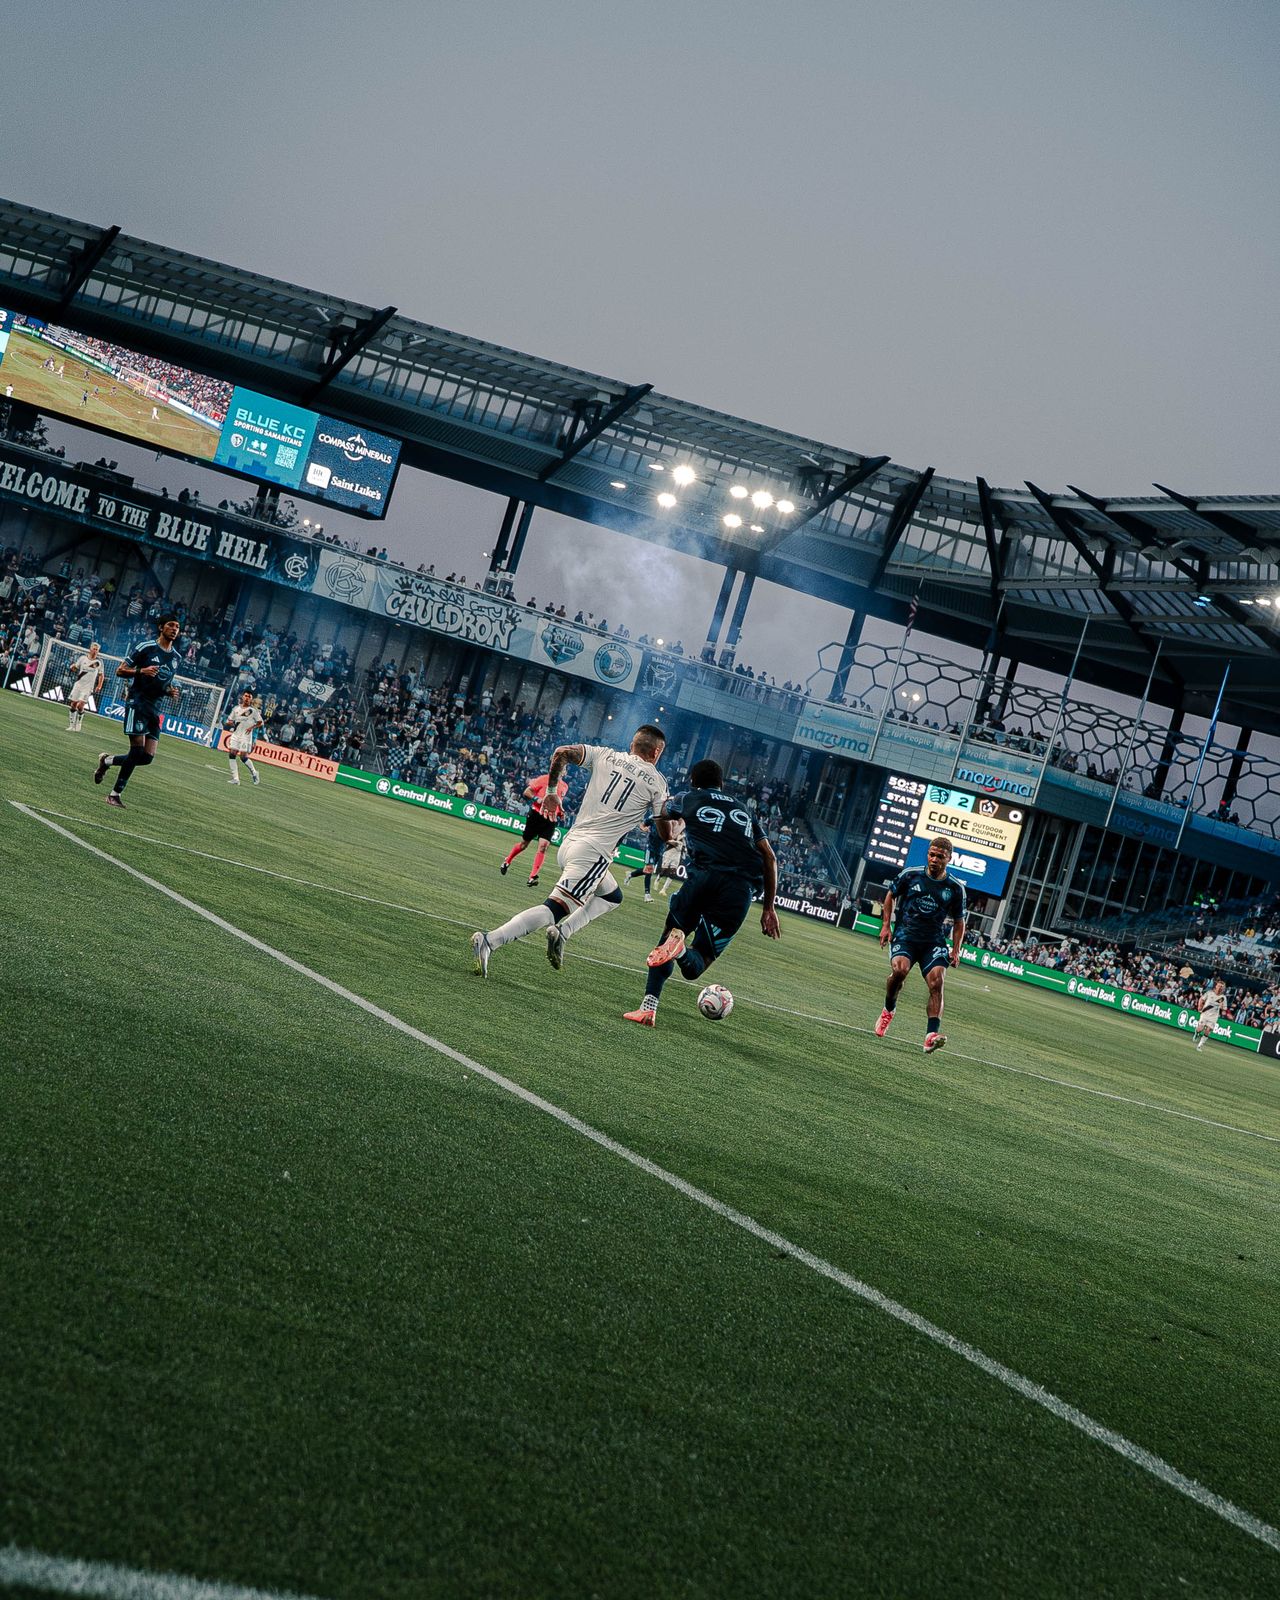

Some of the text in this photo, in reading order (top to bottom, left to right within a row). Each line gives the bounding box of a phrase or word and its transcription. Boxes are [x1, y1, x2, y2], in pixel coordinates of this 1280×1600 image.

[233, 420, 303, 448] SPORTING SAMARITANS
[236, 408, 306, 440] BLUE KC
[318, 434, 393, 464] COMPASS MINERALS
[330, 476, 382, 500] Saint Luke's
[0, 461, 268, 570] ELCOME TO THE BLUE HELL
[415, 582, 465, 606] KANSAS
[385, 588, 518, 651] CAULDRON
[166, 718, 213, 743] ULTRA
[799, 726, 869, 754] mazuma
[223, 734, 334, 775] Cnental Tire
[606, 755, 655, 786] GABRIEL PEC
[600, 770, 636, 812] 11
[888, 776, 926, 793] 50:33
[957, 767, 1033, 798] mazuma
[392, 785, 453, 811] Central Bank
[886, 792, 919, 807] STATS
[957, 797, 970, 808] 2
[479, 810, 526, 831] Central Ba
[696, 806, 754, 838] 99
[887, 819, 905, 828] SAVES
[928, 811, 1004, 834] CORE OUTDOOR
[1008, 810, 1023, 823] 0
[1112, 811, 1176, 842] mazuma
[883, 830, 902, 839] FOULS
[971, 828, 1008, 841] EQUIPMENT
[950, 852, 987, 873] MB
[800, 900, 839, 921] Partner
[962, 949, 978, 962] Bank
[990, 957, 1024, 976] Central Bank
[1077, 983, 1117, 1003] Central Bank
[1131, 998, 1172, 1021] Central Bank
[1213, 1023, 1232, 1038] Bank
